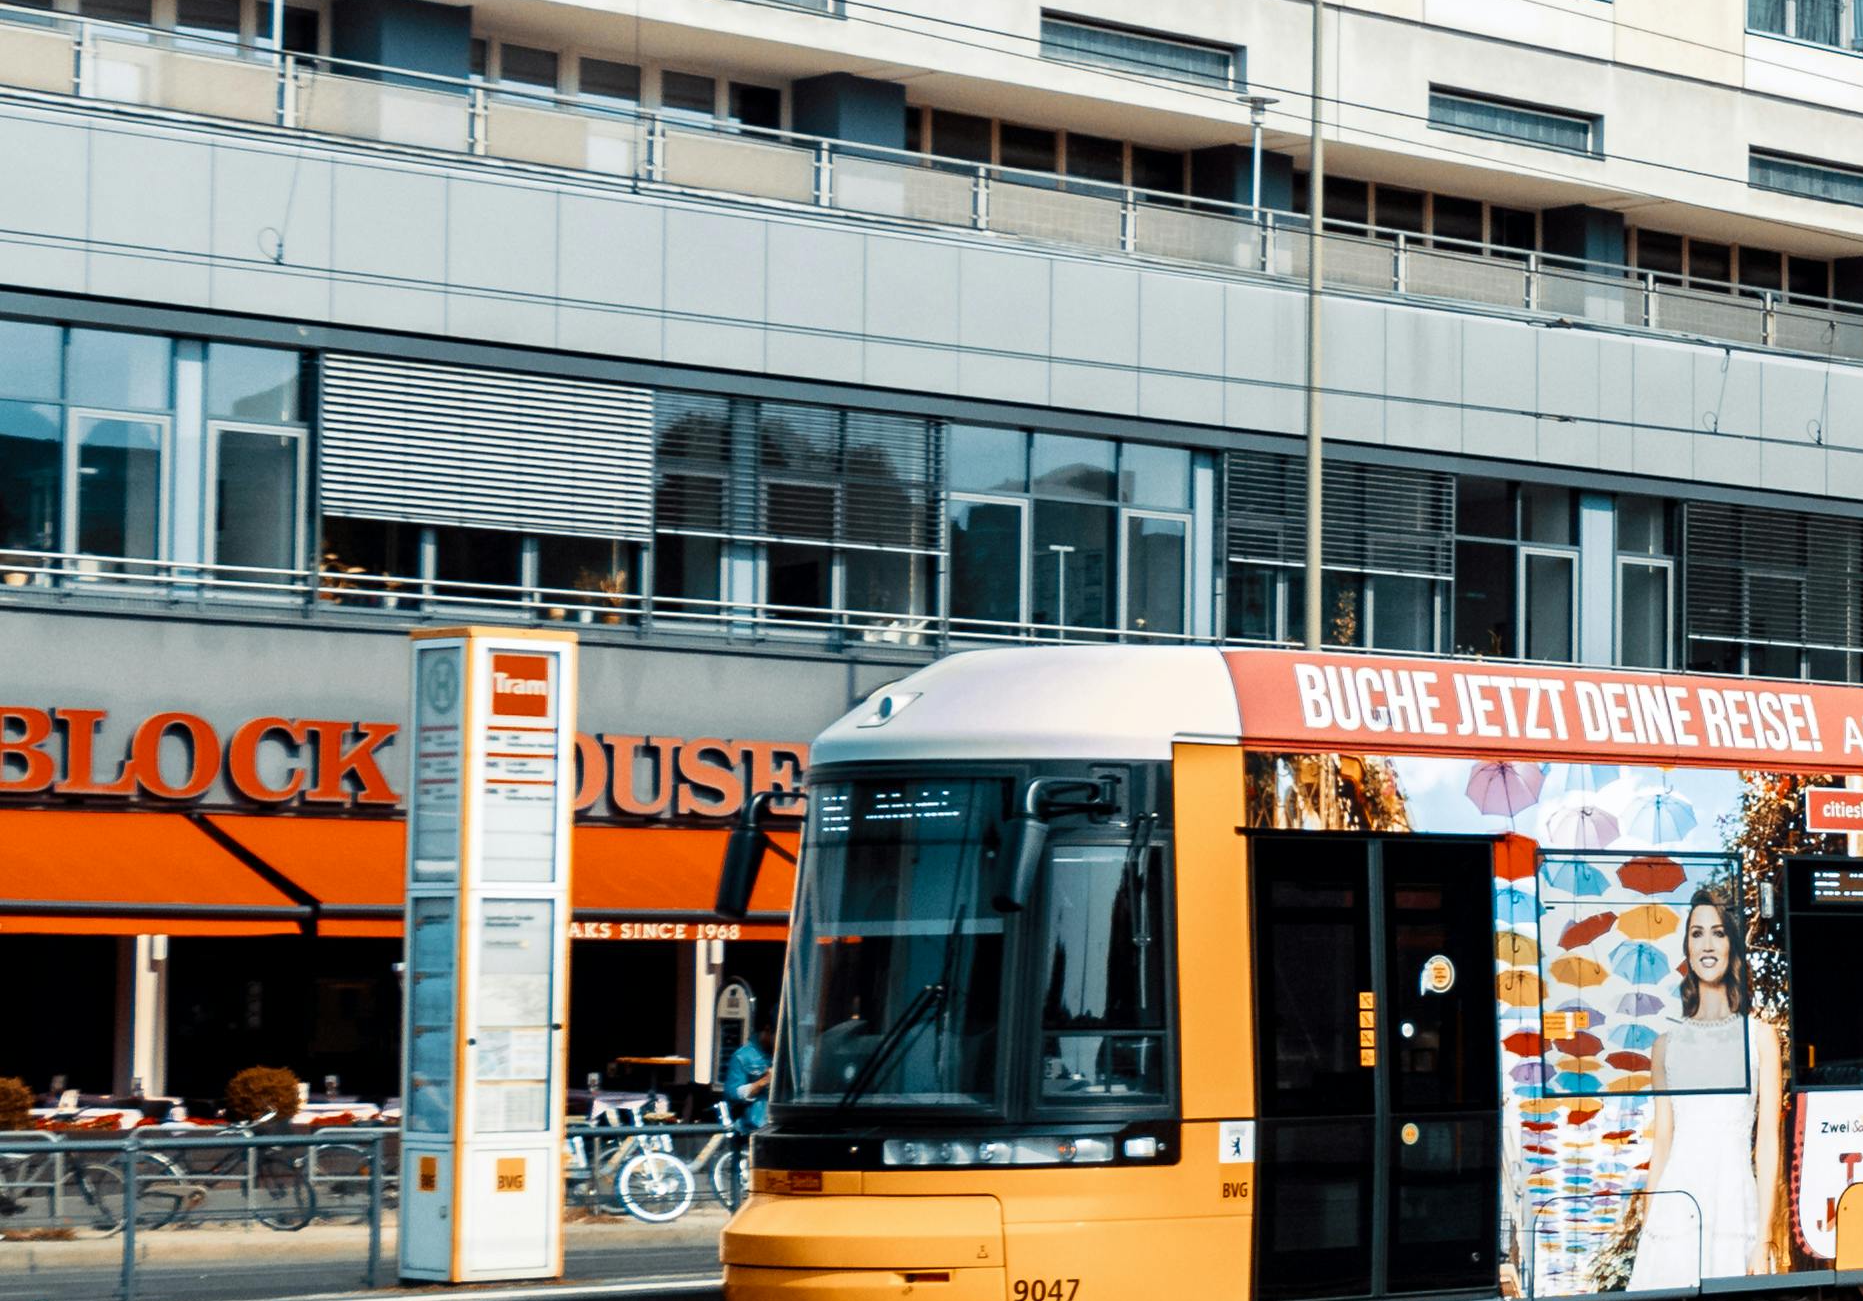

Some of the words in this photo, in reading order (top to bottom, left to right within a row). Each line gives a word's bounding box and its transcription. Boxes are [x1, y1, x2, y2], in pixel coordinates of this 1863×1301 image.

[493, 672, 548, 695] Tram
[1294, 663, 1448, 734] BUCHE
[1452, 673, 1569, 740] JETZT
[1574, 680, 1698, 747] DEINE
[1697, 688, 1823, 752] REISE!
[0, 706, 399, 805] BLOCK
[620, 922, 687, 939] SINCE
[696, 923, 742, 940] 1968
[1820, 1121, 1850, 1133] Zwei
[497, 1175, 523, 1189] BVG
[1222, 1182, 1248, 1198] BVG
